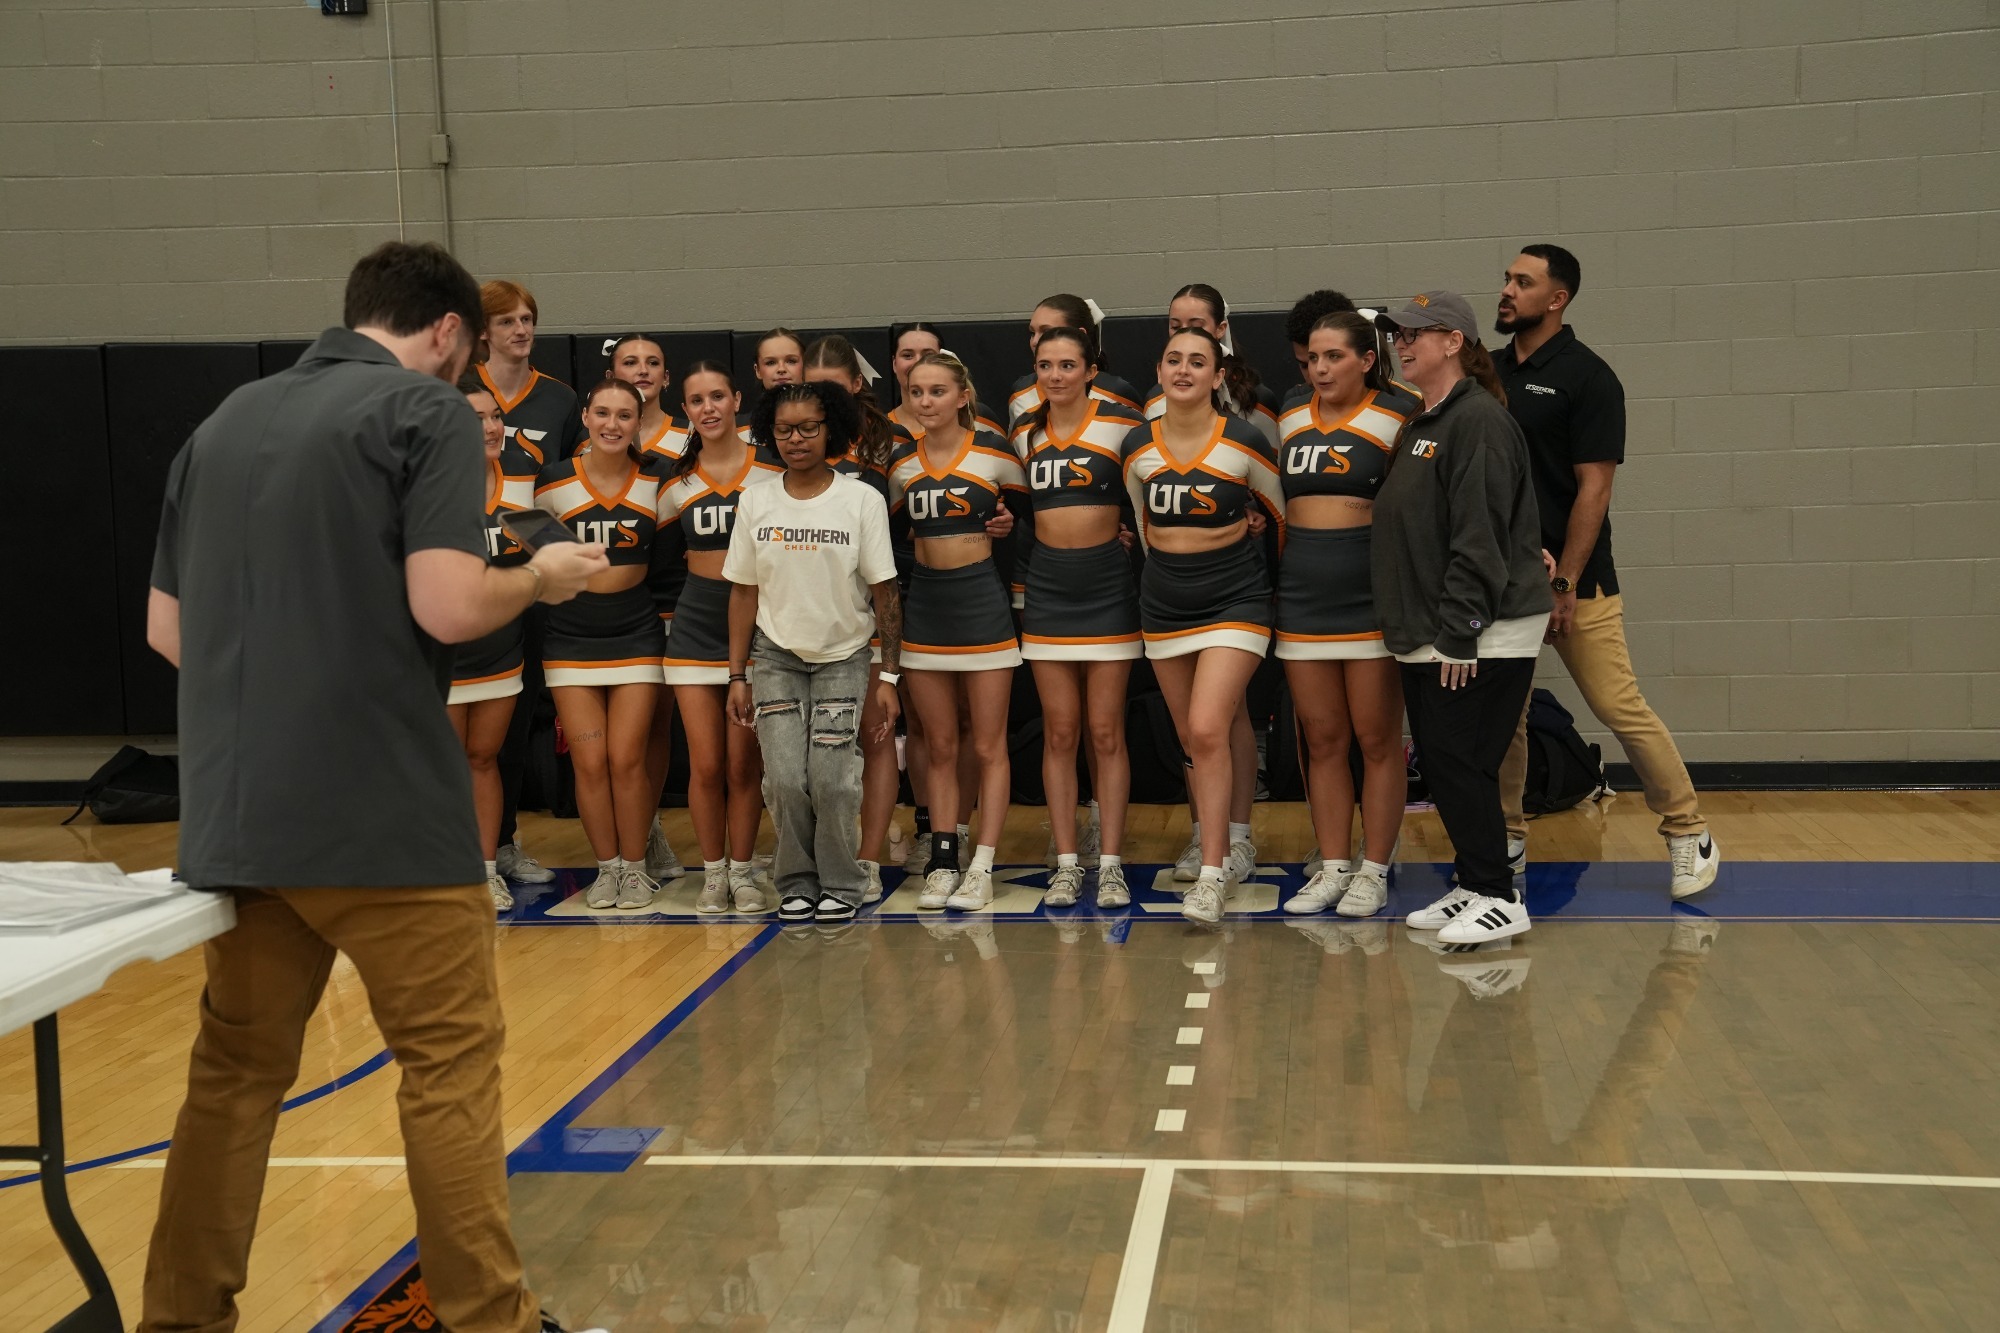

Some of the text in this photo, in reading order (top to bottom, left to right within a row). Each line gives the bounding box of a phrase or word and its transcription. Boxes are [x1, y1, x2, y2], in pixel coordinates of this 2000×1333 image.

[1286, 445, 1353, 475] UTS
[1411, 438, 1438, 459] UTS
[1030, 457, 1093, 490] UTS
[908, 486, 971, 520] UTS
[1149, 483, 1217, 515] UTS
[576, 519, 639, 549] UTS
[693, 505, 738, 535] UT
[784, 544, 818, 552] CHEER
